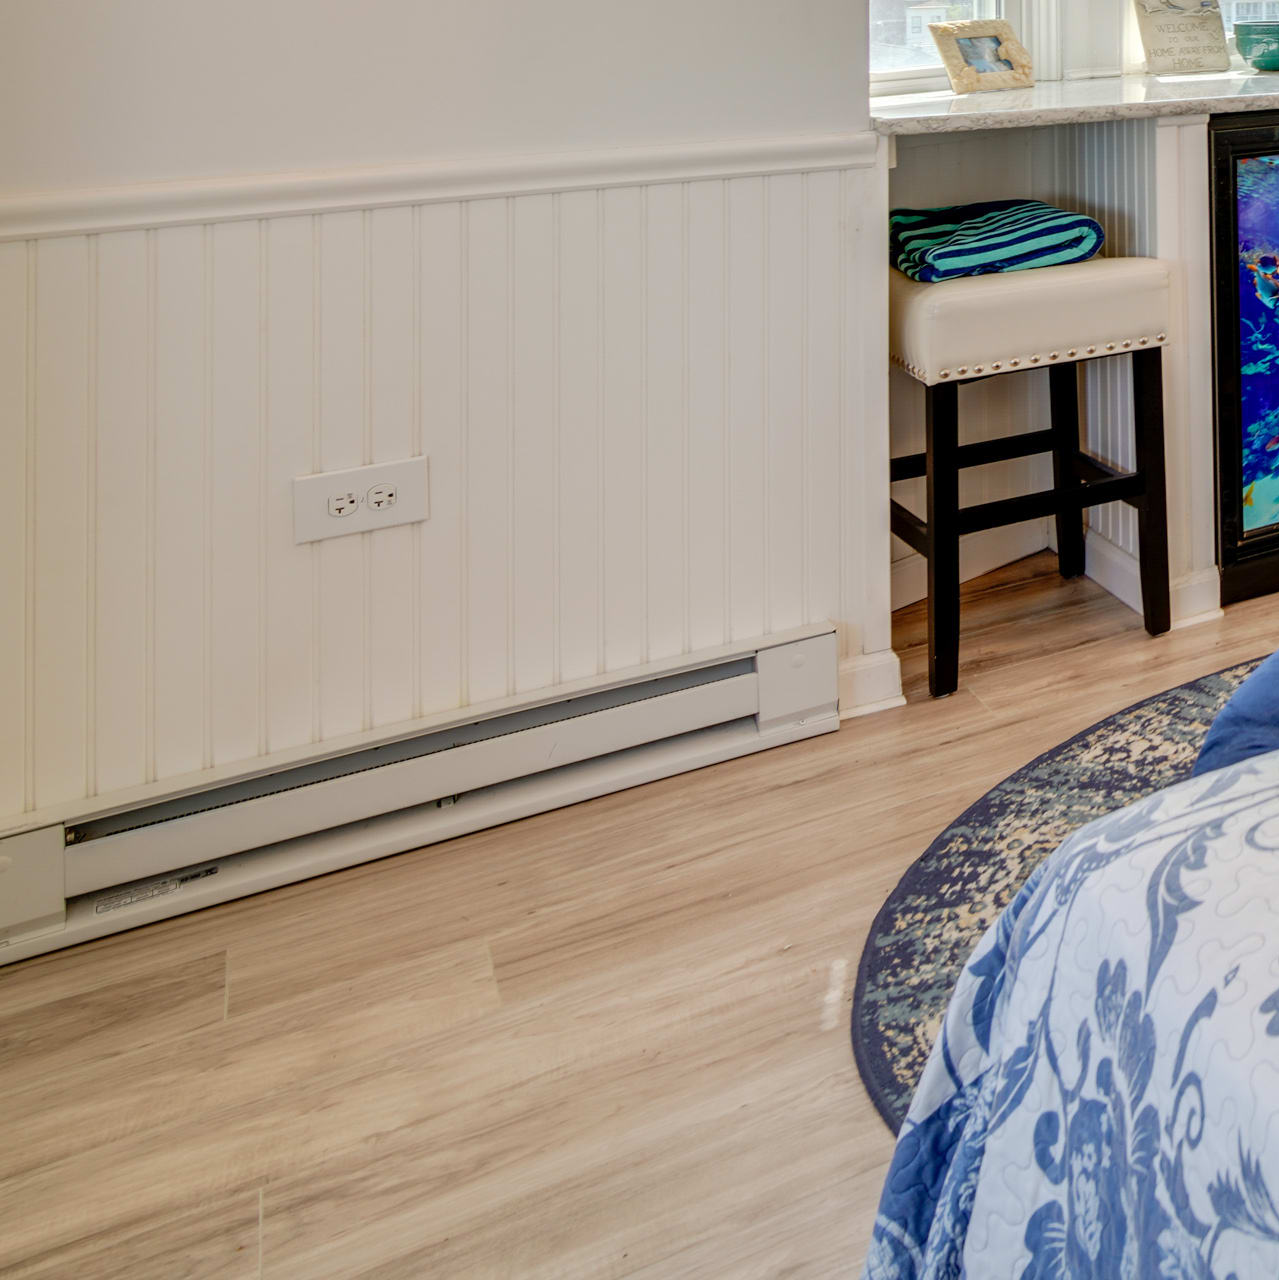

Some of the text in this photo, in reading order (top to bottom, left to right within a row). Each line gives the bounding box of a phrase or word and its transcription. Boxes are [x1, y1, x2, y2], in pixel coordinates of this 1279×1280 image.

[1155, 23, 1209, 33] WELCOME
[1150, 47, 1176, 57] HOME
[1173, 57, 1205, 70] HOME
